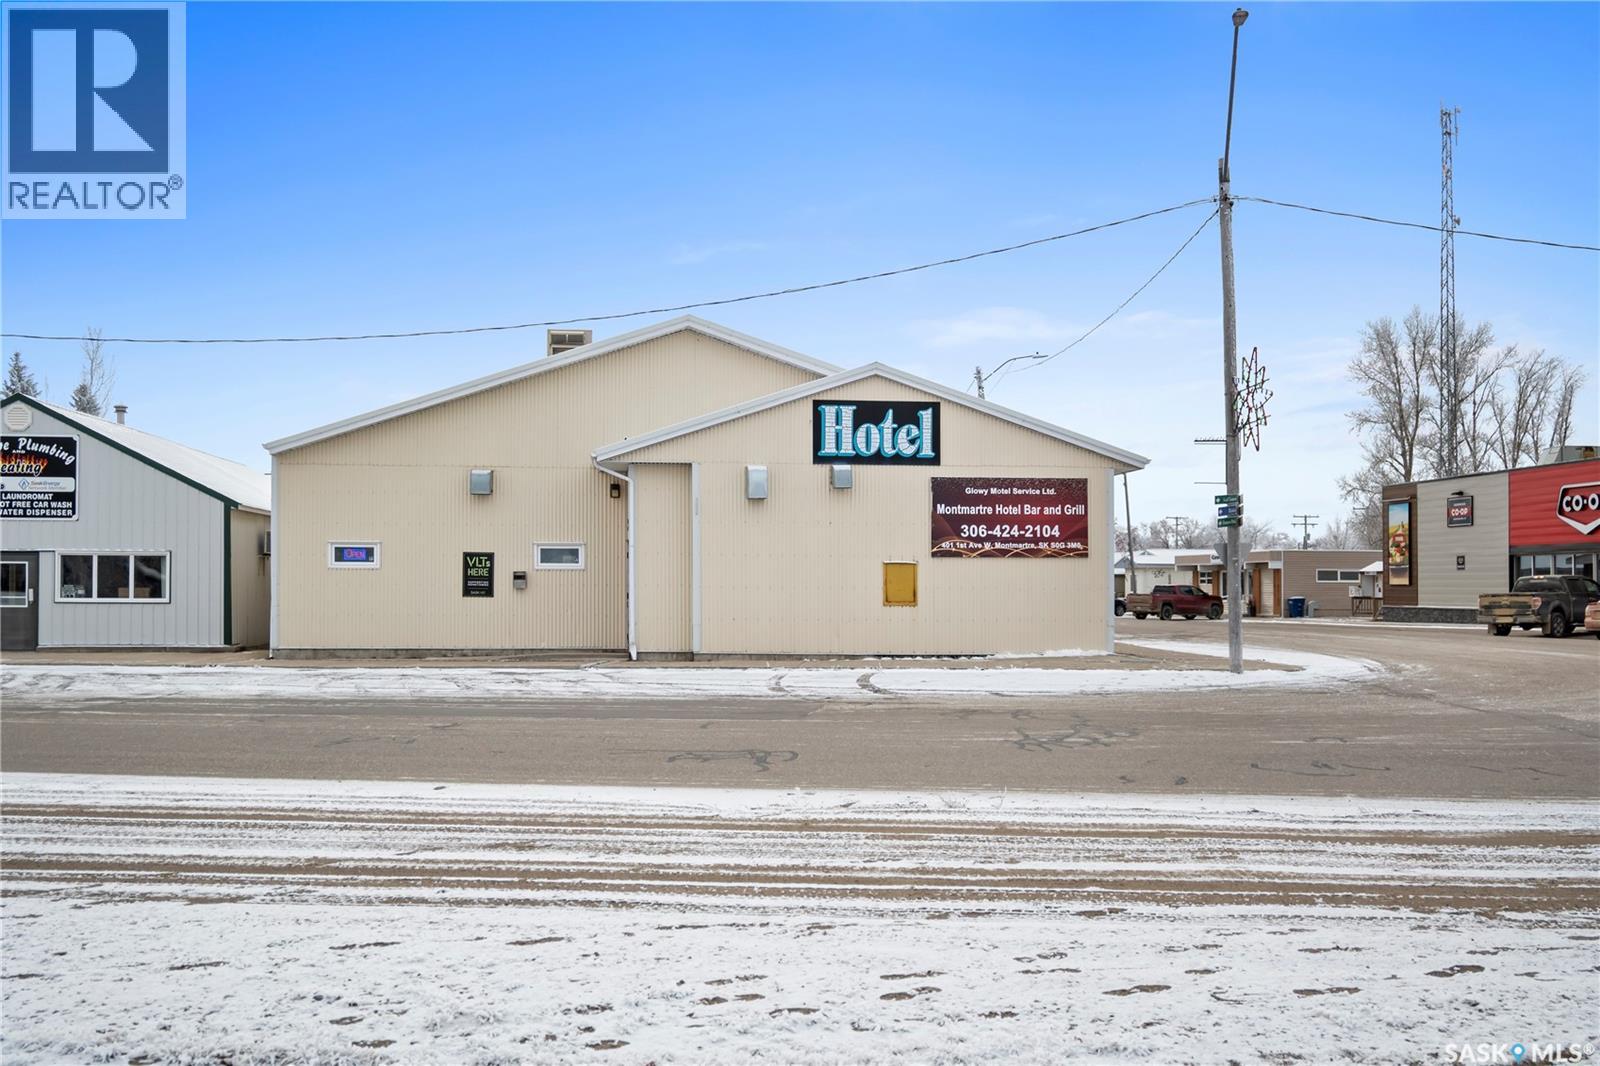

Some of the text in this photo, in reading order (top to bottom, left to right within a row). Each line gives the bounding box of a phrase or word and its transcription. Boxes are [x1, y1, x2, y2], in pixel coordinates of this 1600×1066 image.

[817, 405, 935, 458] Hotel
[18, 438, 76, 465] Plumbing
[965, 487, 1057, 496] Glowy Motel Service Ltd.
[26, 508, 73, 516] DISPENSER
[937, 504, 1085, 515] Montmartre Hotel Bar and Grill
[960, 524, 1060, 538] 306-424-2104
[956, 541, 966, 549] 1st
[969, 541, 983, 549] Ave
[1039, 541, 1049, 549] SK
[466, 556, 491, 567] VLTs
[467, 568, 490, 577] HERE
